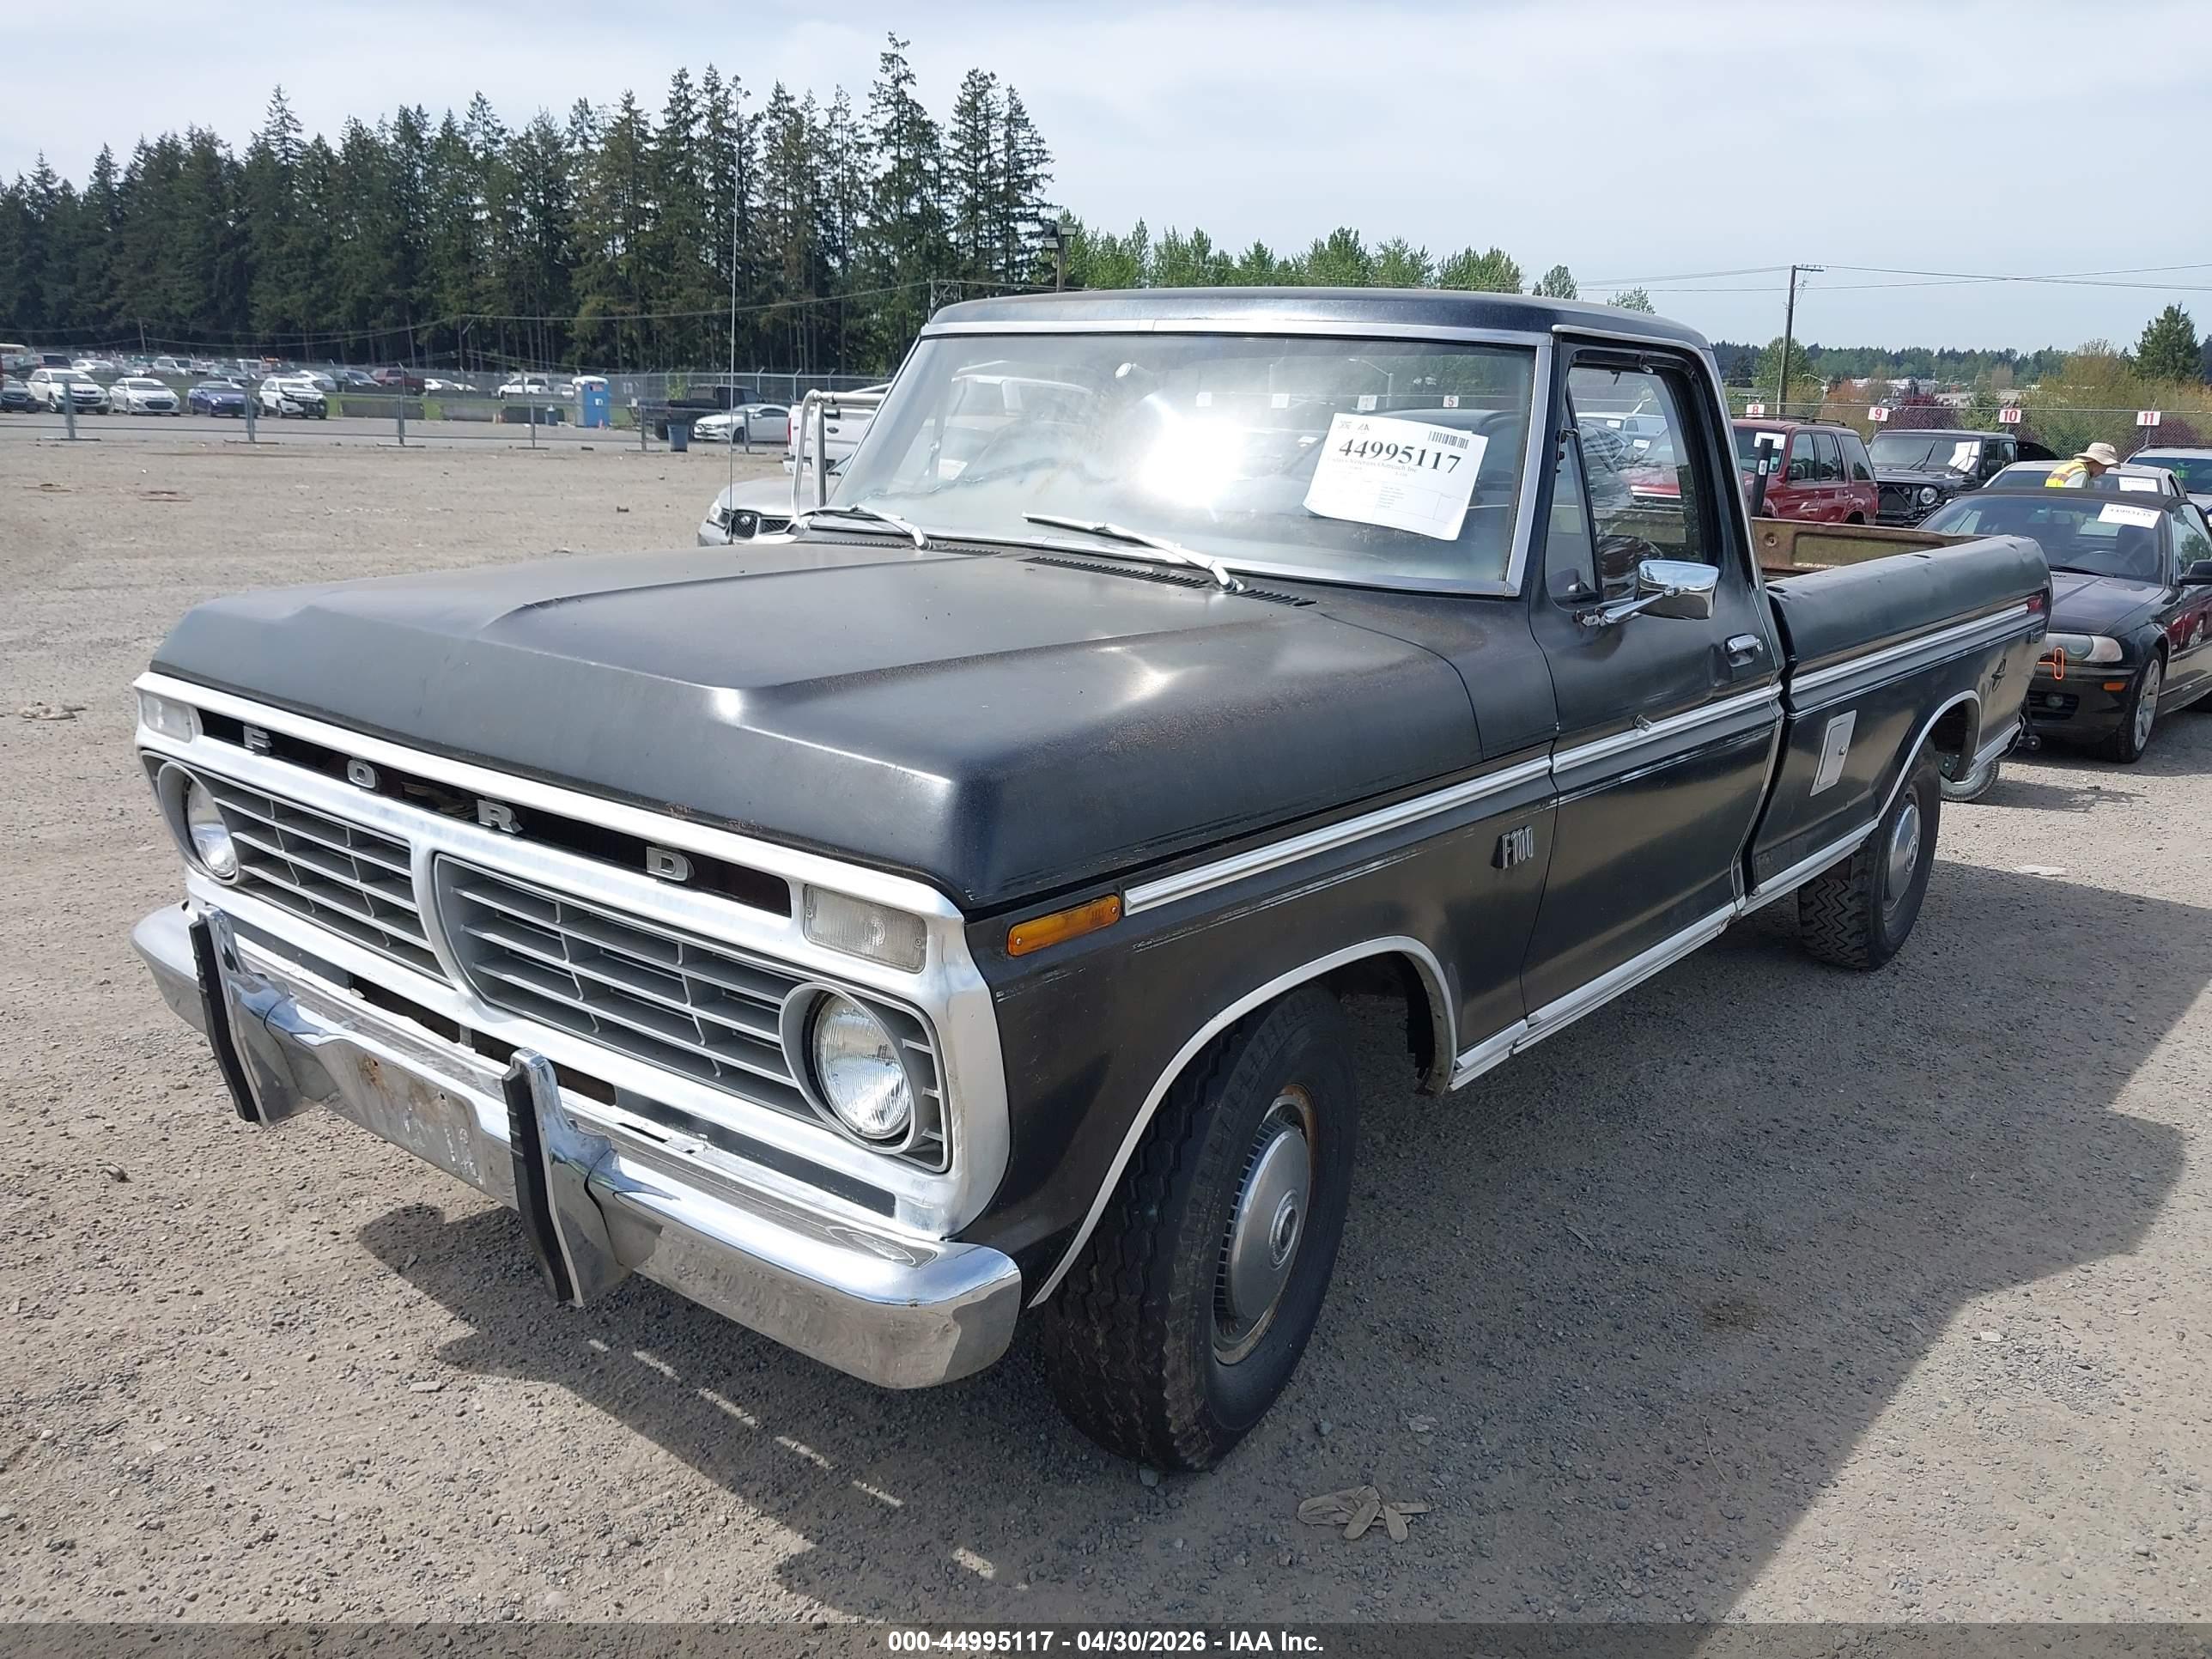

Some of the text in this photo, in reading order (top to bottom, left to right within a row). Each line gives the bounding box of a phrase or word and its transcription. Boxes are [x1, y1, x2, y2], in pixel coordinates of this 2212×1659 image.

[1447, 397, 1455, 407] 5
[1752, 404, 1759, 415] 8
[1874, 408, 1883, 420] 9
[2002, 409, 2018, 422] 10
[2142, 412, 2154, 424] 11
[1339, 438, 1462, 474] 44995117
[243, 725, 695, 883] FORD
